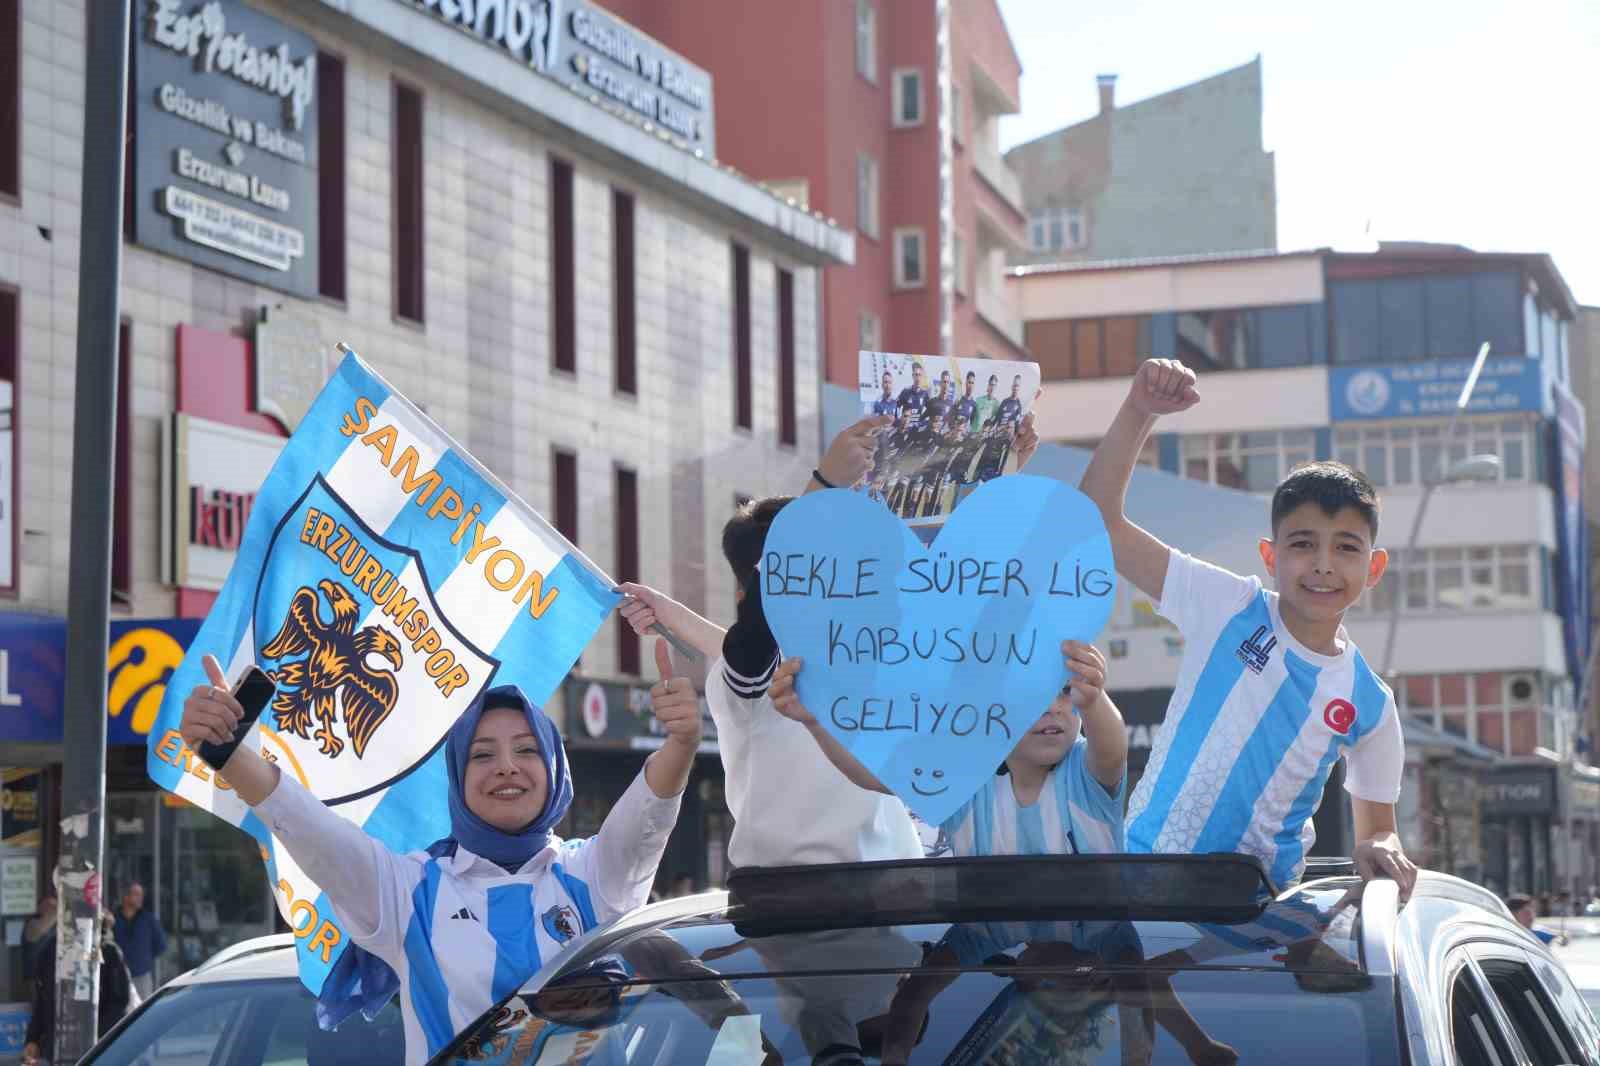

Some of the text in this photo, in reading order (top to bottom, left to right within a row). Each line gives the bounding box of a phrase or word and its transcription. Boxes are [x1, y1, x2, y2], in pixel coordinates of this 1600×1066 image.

[340, 397, 560, 620] ŞAMPİYON
[766, 552, 879, 599] BEKLE
[900, 552, 1029, 597] SÜPER
[300, 507, 471, 698] ERZURUMSPOR
[828, 619, 1037, 666] KABUSUN
[831, 693, 1012, 740] GELİYOR
